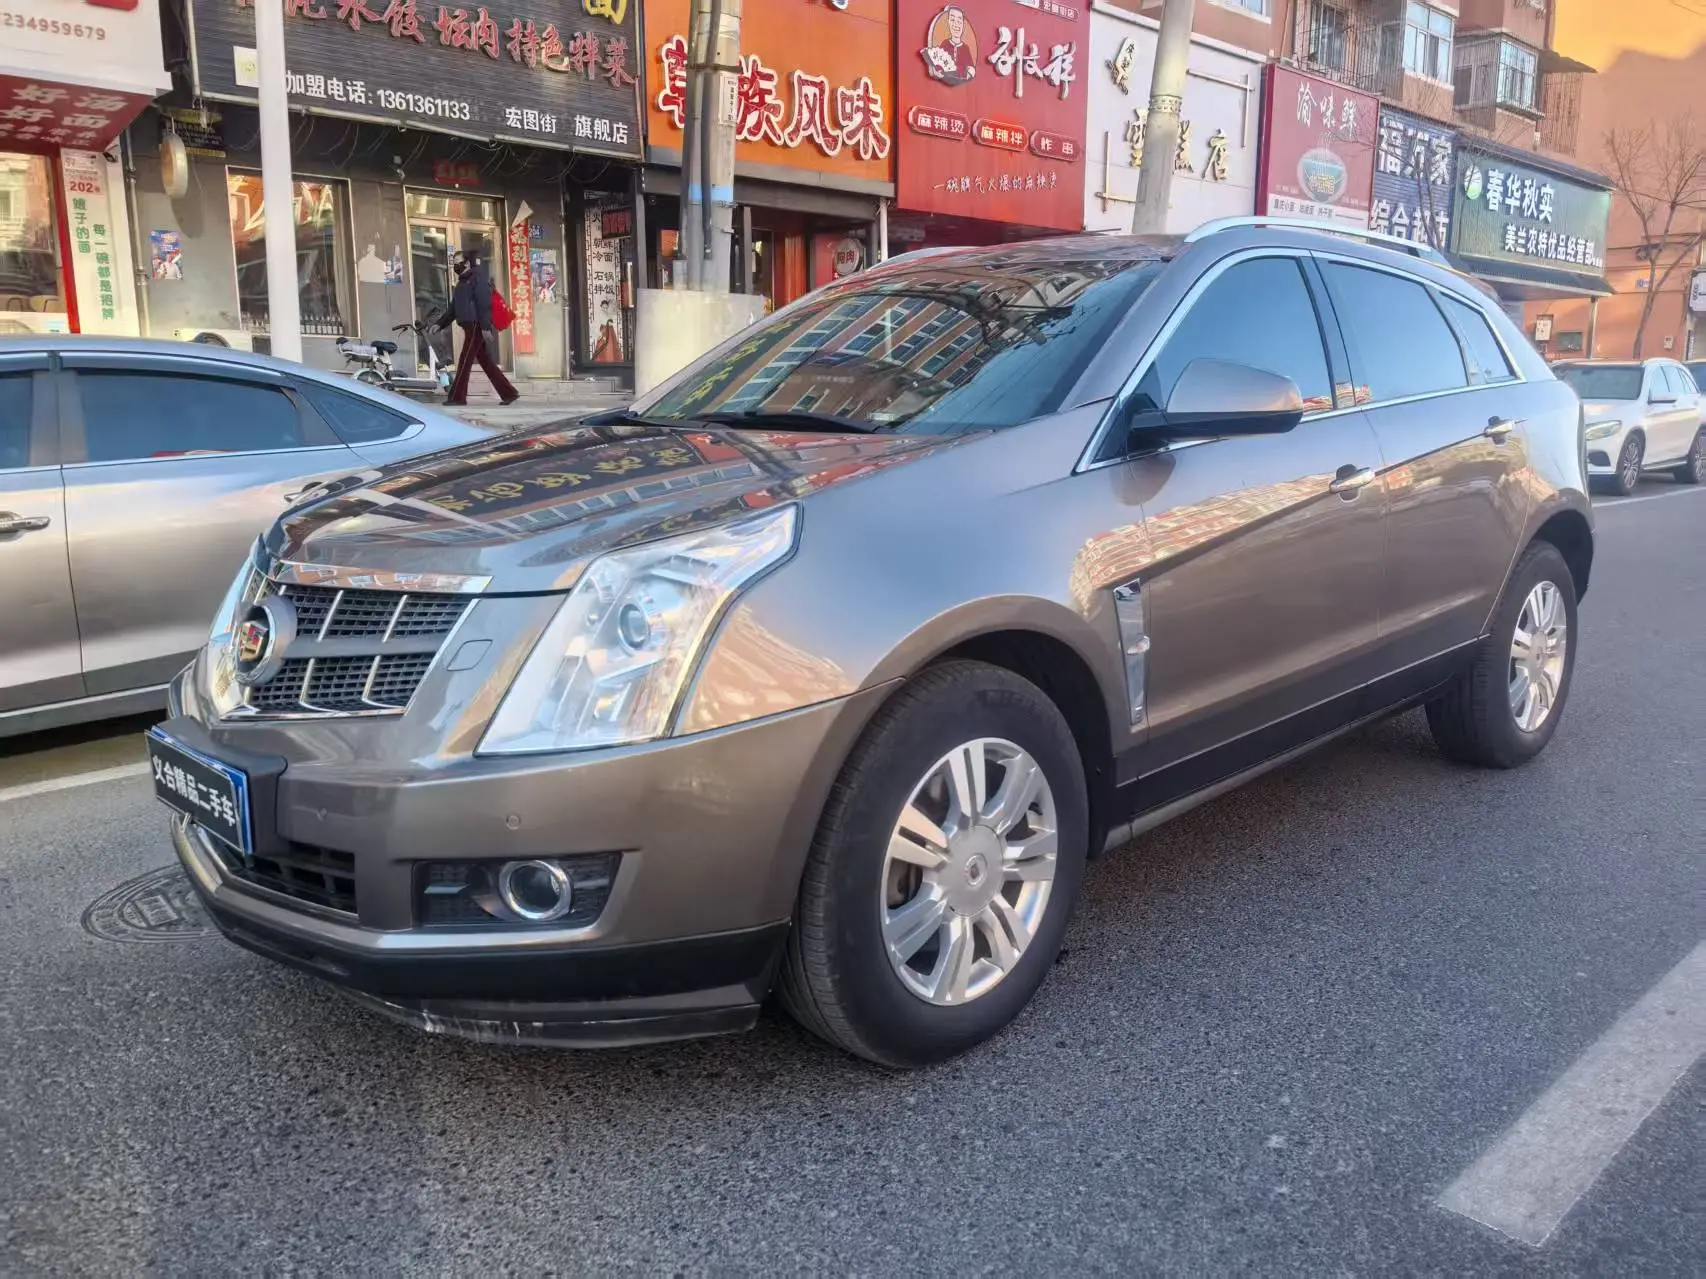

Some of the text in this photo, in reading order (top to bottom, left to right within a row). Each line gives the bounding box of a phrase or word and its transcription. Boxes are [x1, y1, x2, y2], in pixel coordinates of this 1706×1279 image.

[505, 106, 557, 134] 宏图街
[574, 114, 628, 145] 旗舰店
[917, 113, 964, 134] 麻辣烫
[981, 126, 1023, 145] 麻辣拌
[1486, 168, 1555, 222] 春华秋实
[593, 251, 614, 262] 冷面
[594, 271, 614, 282] 石锅
[594, 283, 615, 295] 拌饭
